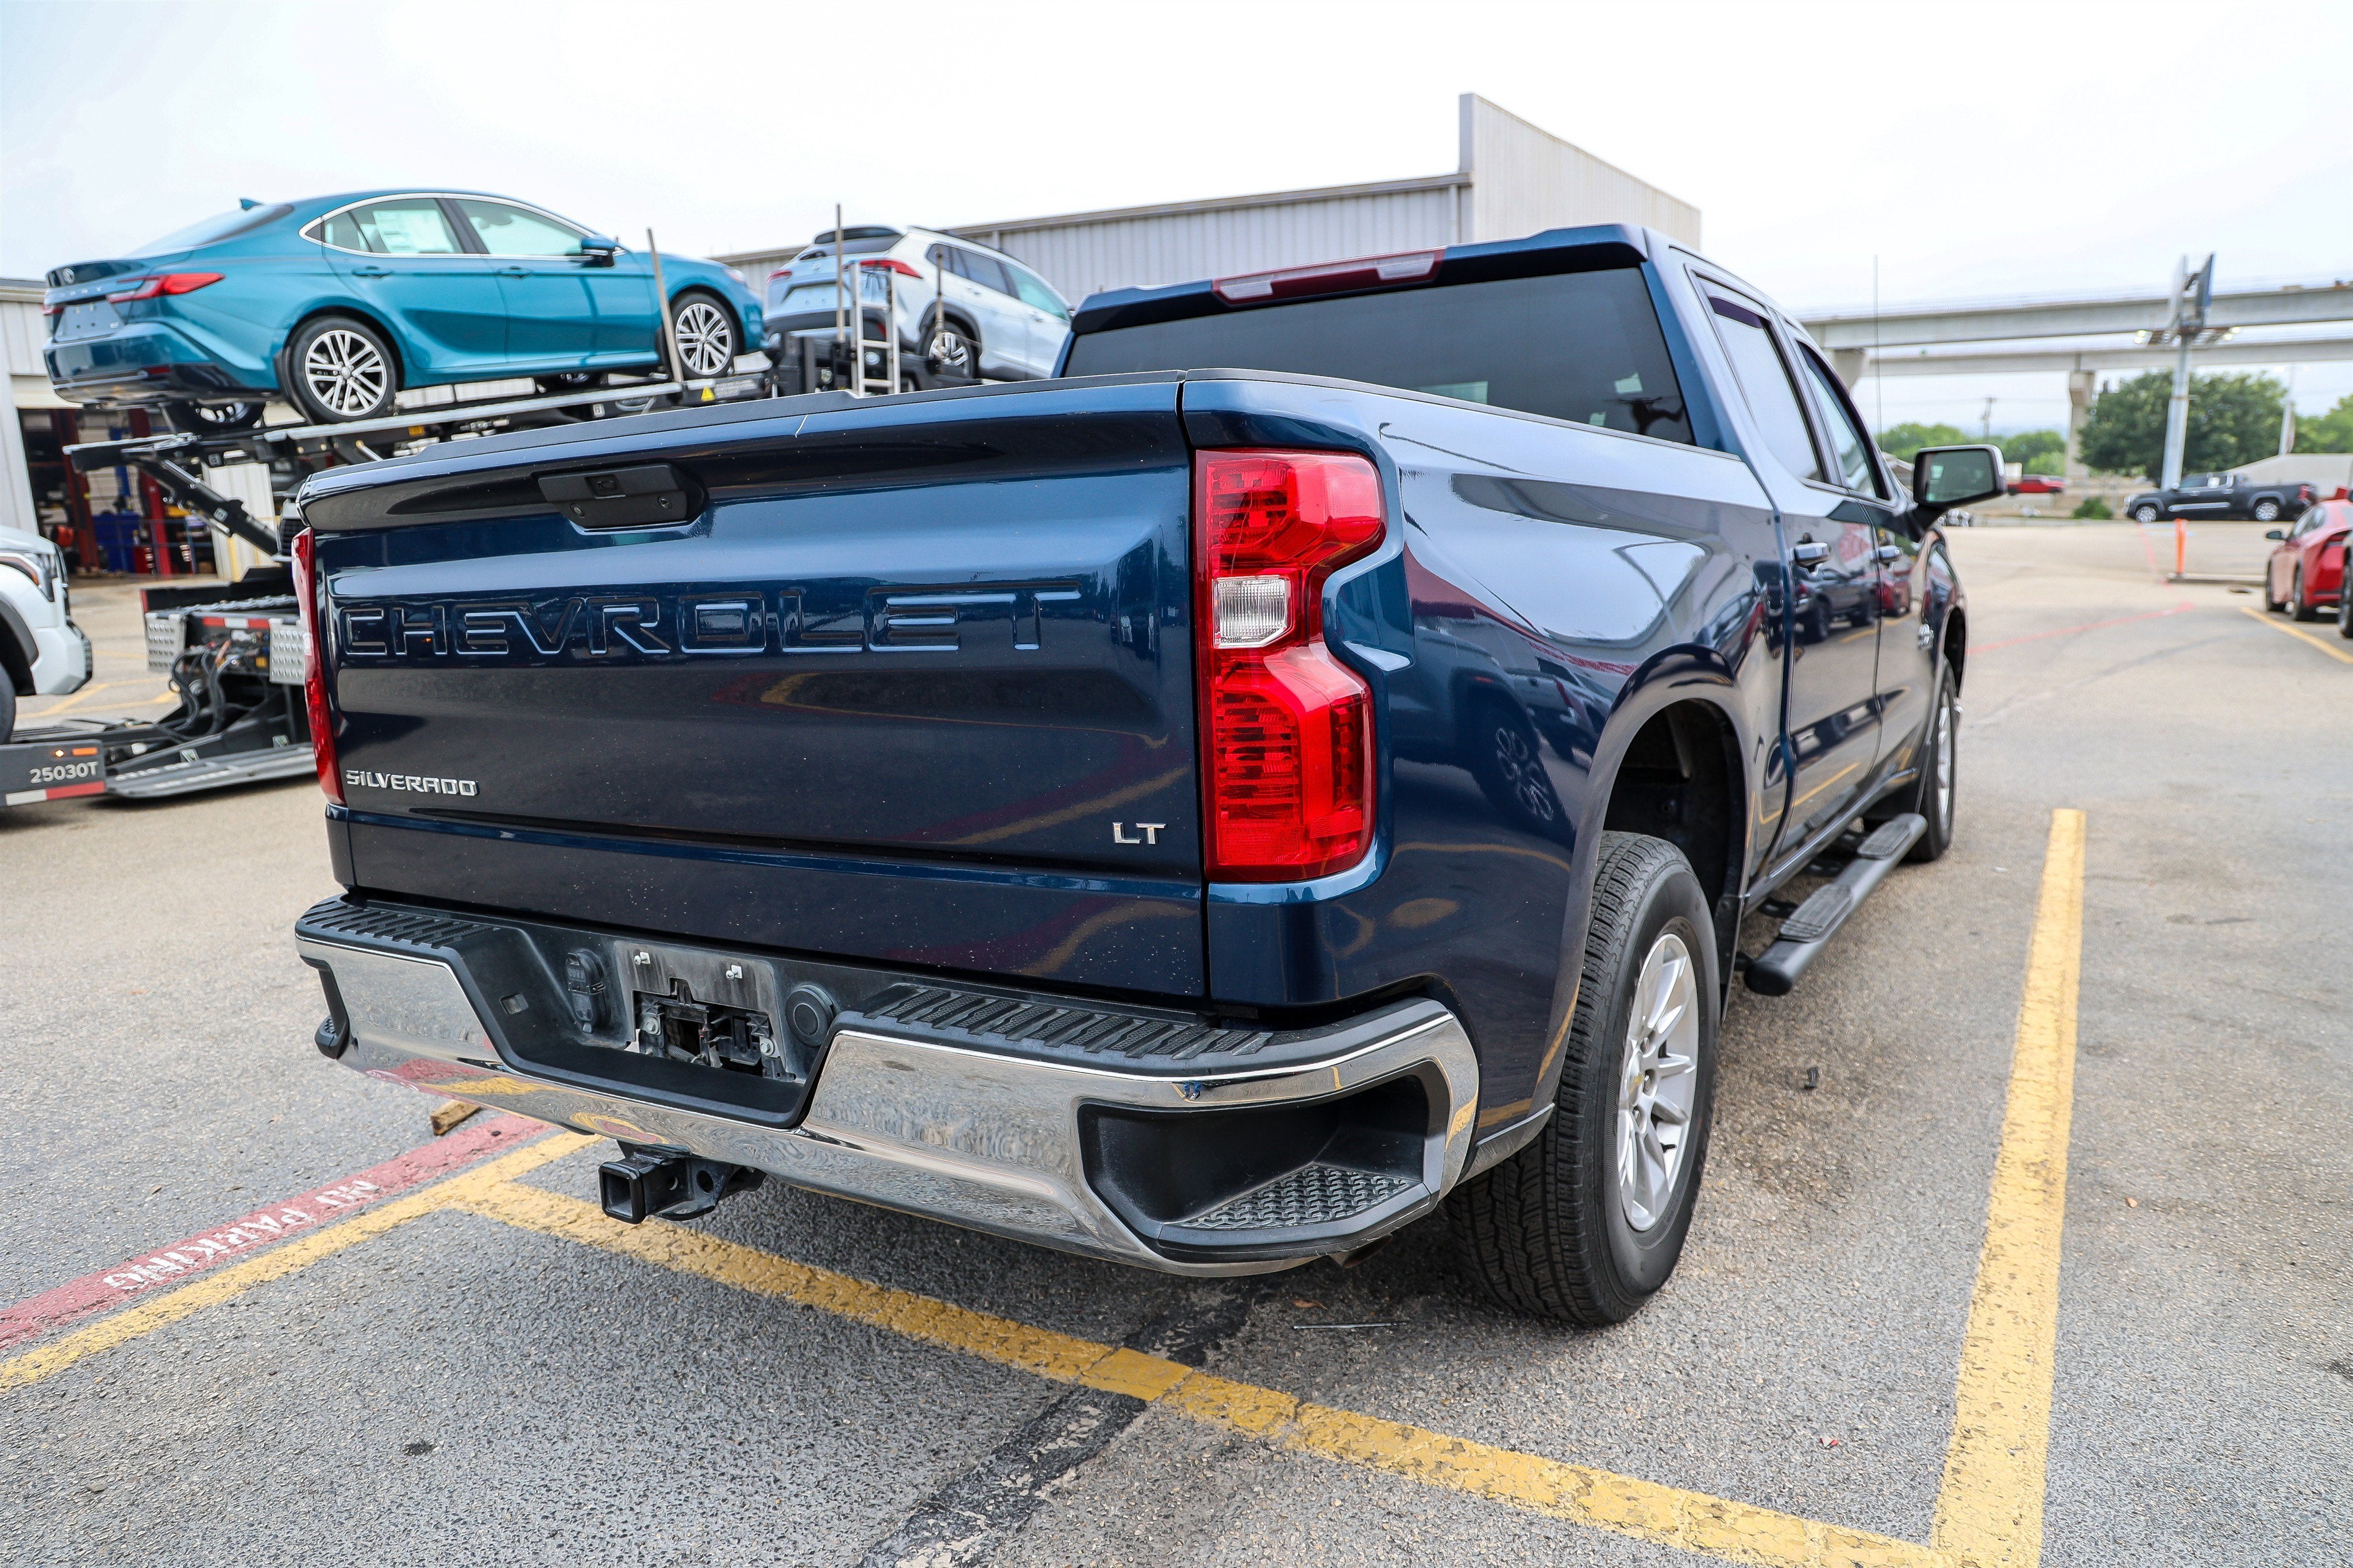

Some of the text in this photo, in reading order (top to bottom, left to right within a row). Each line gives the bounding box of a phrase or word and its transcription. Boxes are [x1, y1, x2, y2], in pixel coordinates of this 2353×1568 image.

[342, 581, 1081, 656] CHEVROLET
[29, 761, 99, 784] 25030T
[346, 770, 477, 796] SILVERADO
[1112, 822, 1167, 844] LT
[102, 1179, 380, 1291] NO PARKING
